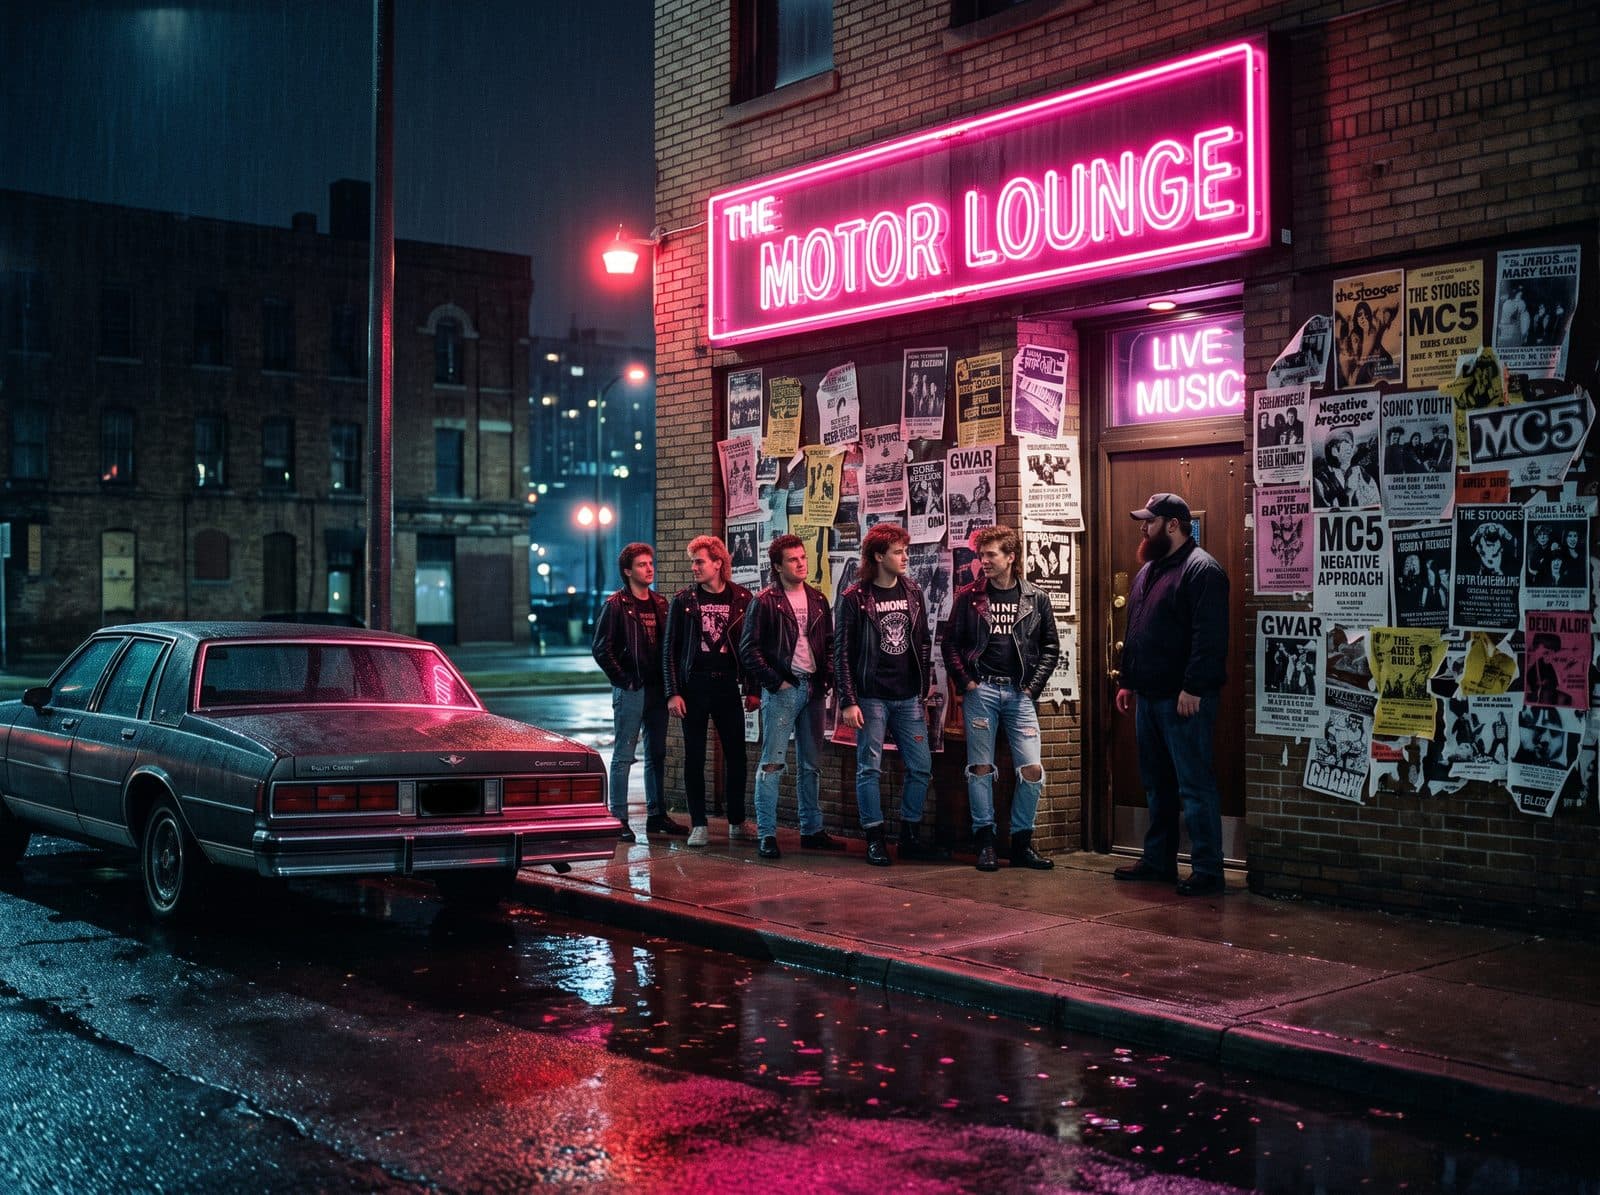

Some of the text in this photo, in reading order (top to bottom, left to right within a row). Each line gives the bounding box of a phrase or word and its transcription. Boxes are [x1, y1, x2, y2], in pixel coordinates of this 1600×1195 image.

[722, 194, 780, 242] THE
[760, 127, 1236, 310] MOTOR LOUNGE
[1335, 283, 1401, 304] the stooges
[1408, 280, 1480, 304] THE STOOGES
[1409, 300, 1479, 336] MC5
[1152, 328, 1225, 371] LIVE
[1136, 369, 1242, 416] MUSIC
[1319, 397, 1368, 414] Negative
[1383, 396, 1452, 418] SONIC YOUTH
[1473, 405, 1586, 459] MC5
[950, 449, 993, 471] GWAR
[1459, 510, 1477, 521] THE
[1478, 509, 1525, 521] STOOGES
[1319, 515, 1384, 552] MC5
[1320, 555, 1380, 570] NEGATIVE
[1318, 571, 1384, 587] APPROACH
[1261, 615, 1323, 637] GWAR
[1393, 636, 1411, 646] THE
